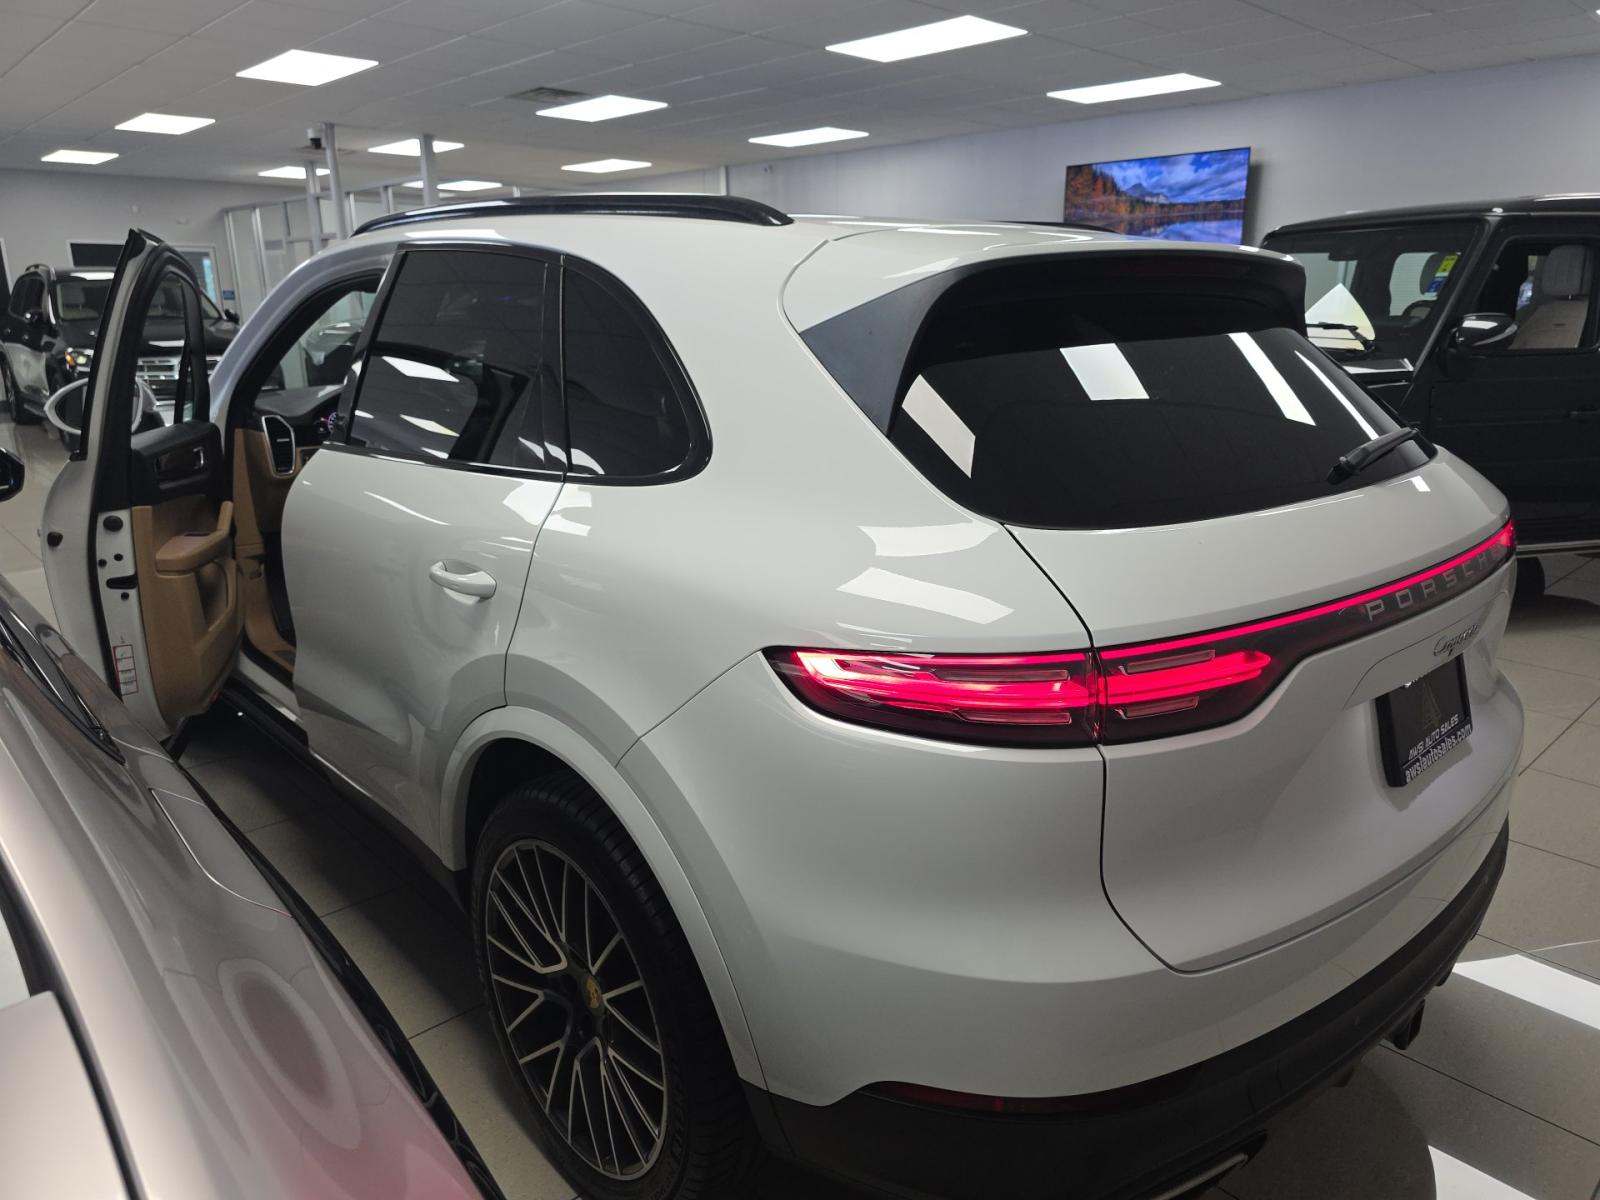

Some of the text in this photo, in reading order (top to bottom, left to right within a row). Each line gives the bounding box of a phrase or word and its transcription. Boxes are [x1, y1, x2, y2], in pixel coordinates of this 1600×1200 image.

[1365, 545, 1503, 622] PORSCH
[1425, 728, 1440, 748] AUTO
[1440, 714, 1459, 735] SALES
